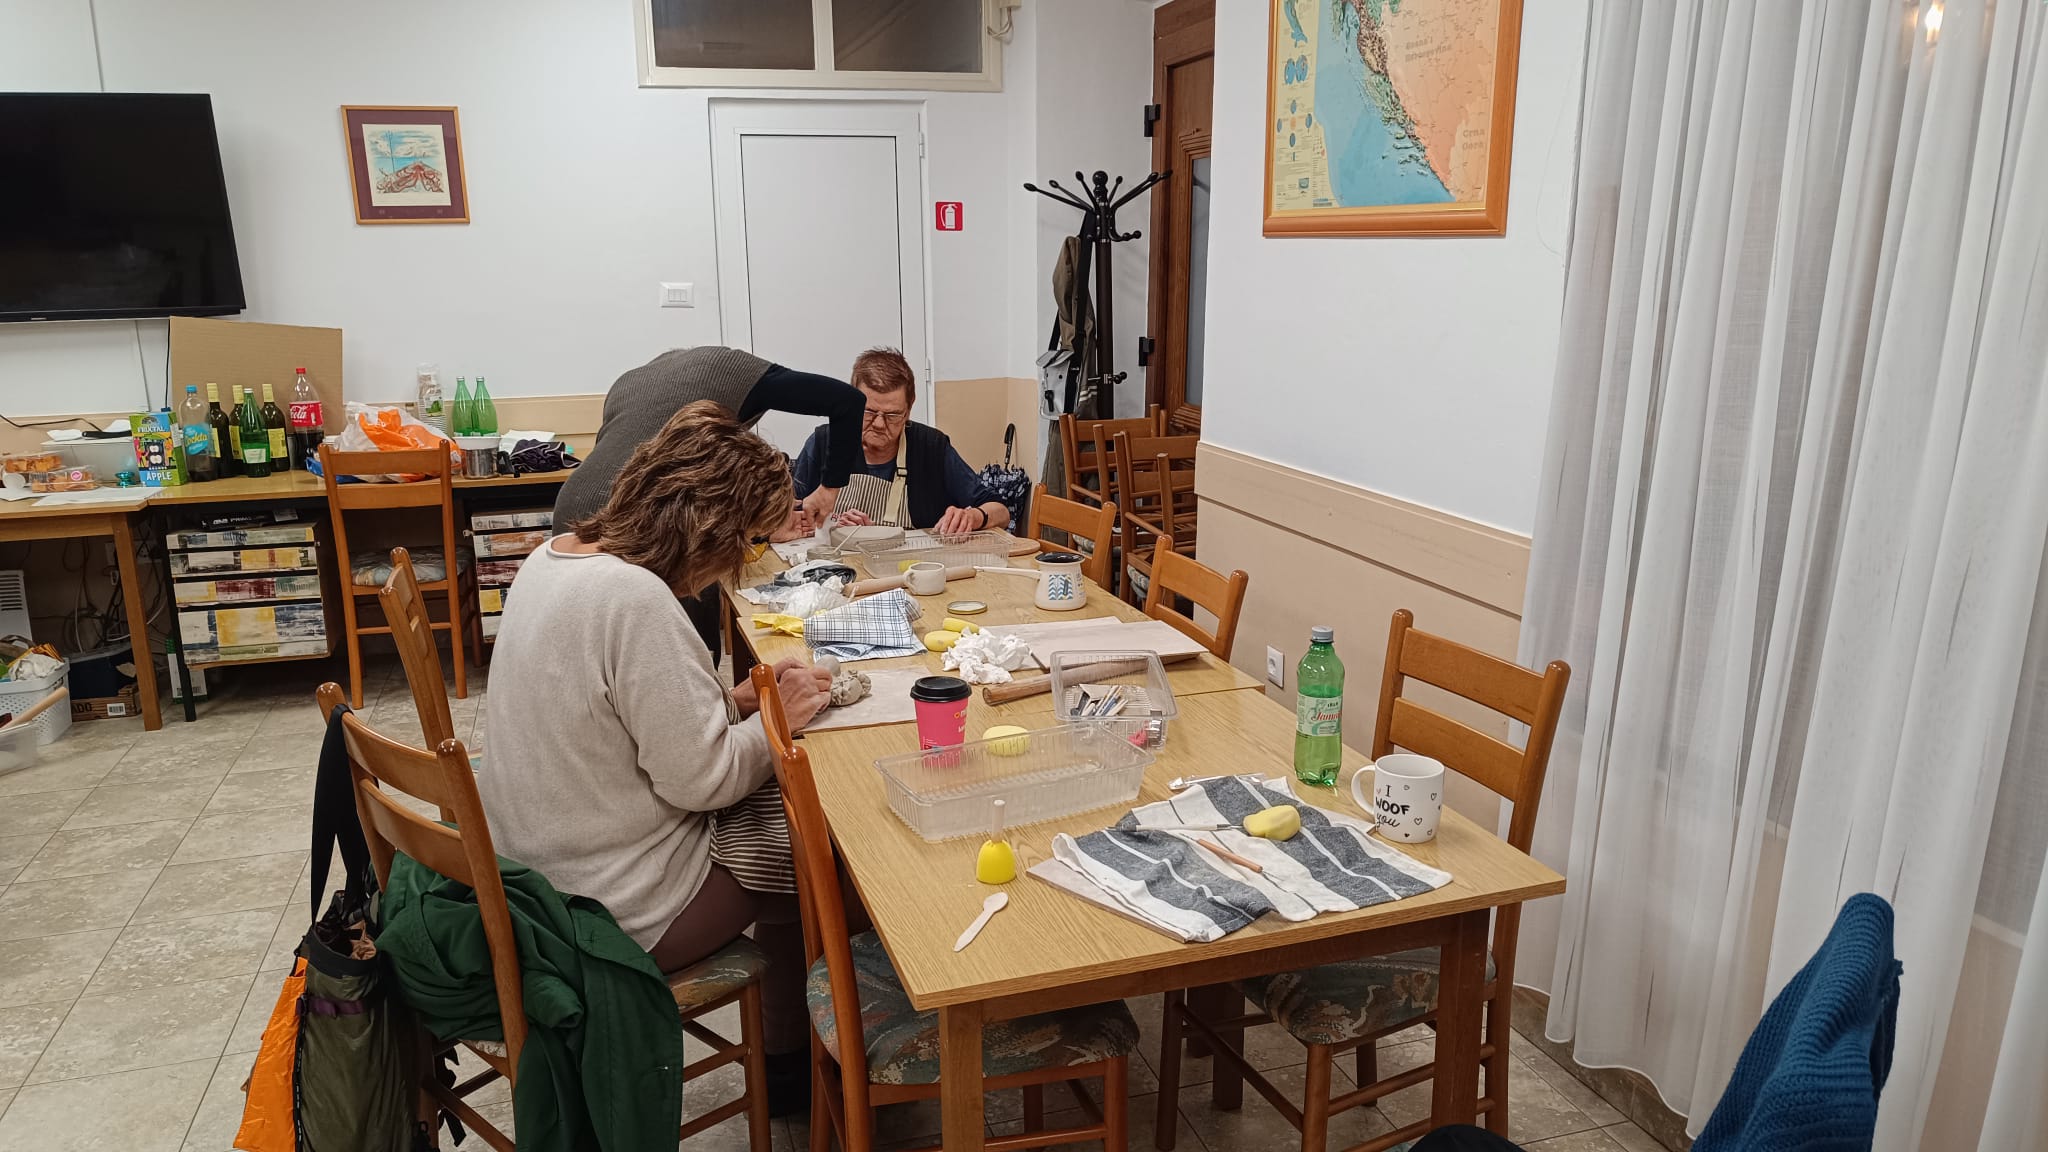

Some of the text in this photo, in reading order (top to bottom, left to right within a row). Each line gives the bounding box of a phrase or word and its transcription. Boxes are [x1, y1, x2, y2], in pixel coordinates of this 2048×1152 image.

[146, 471, 172, 481] APPLE
[1385, 785, 1392, 798] I
[1375, 796, 1411, 815] WOOF
[1376, 813, 1401, 829] you
